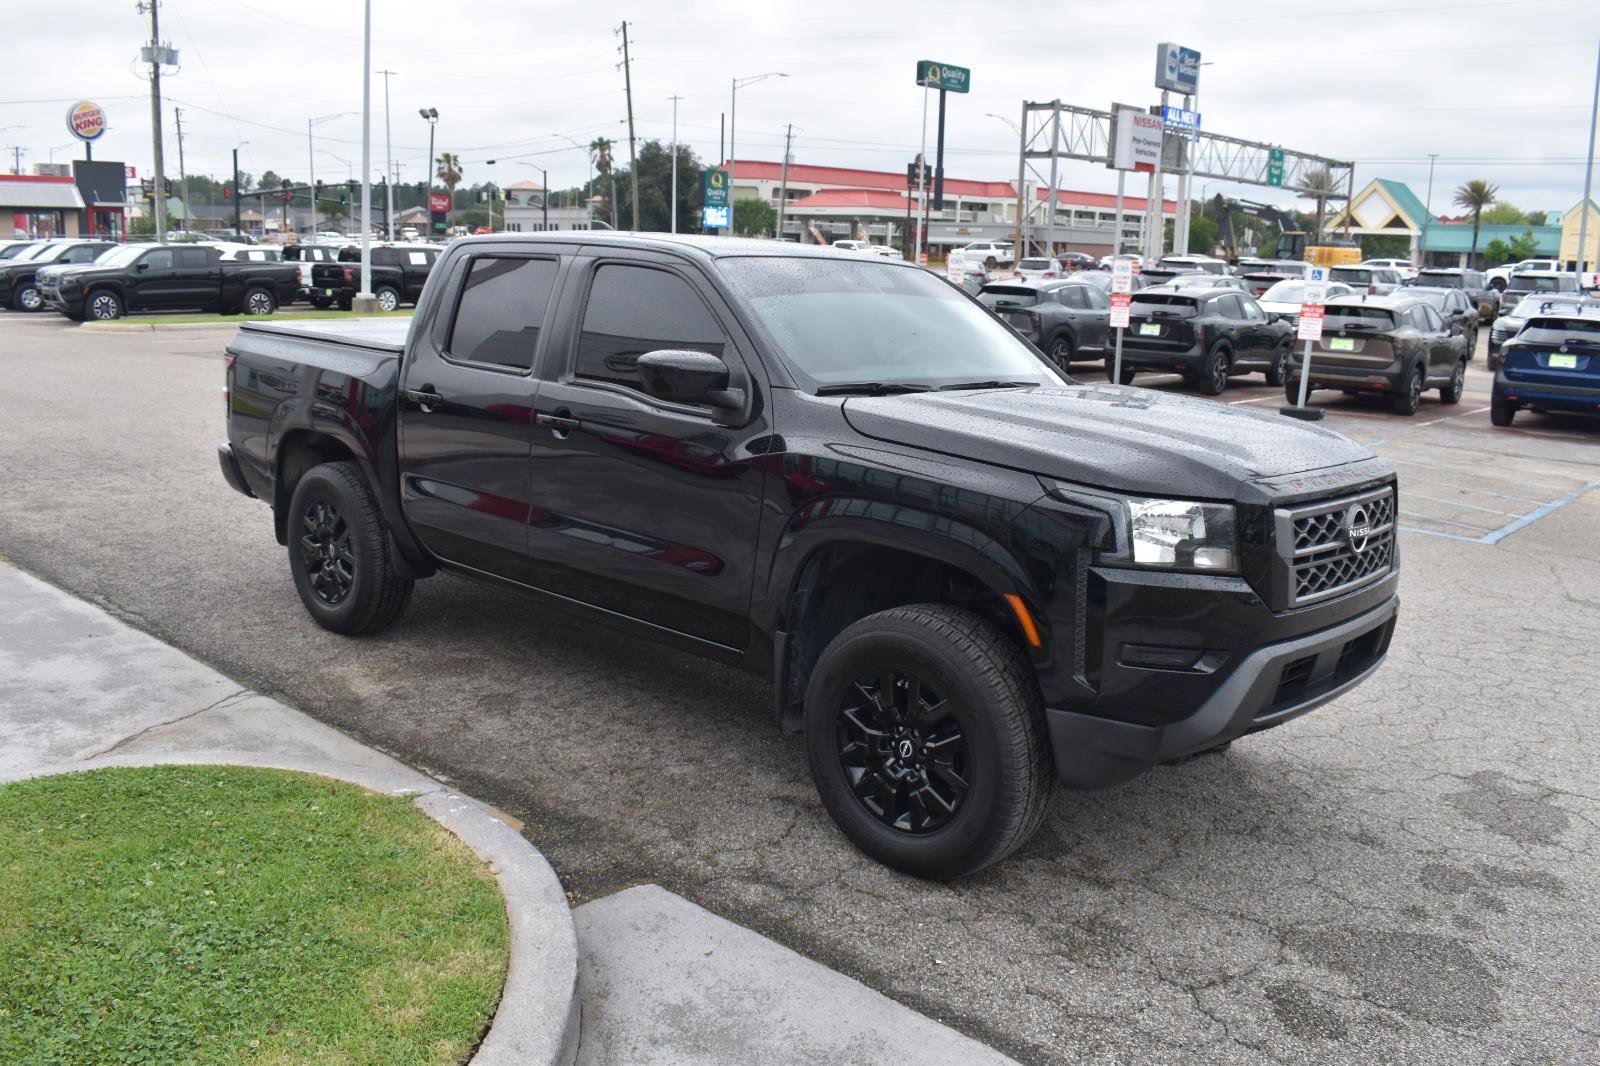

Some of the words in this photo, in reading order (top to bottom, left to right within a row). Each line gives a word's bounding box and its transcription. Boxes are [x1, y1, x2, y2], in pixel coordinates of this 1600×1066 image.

[942, 67, 965, 82] Quality
[73, 110, 101, 121] BURGER
[1167, 108, 1181, 121] ALL
[75, 117, 103, 130] KING
[1133, 116, 1162, 129] NISSAN
[1132, 136, 1160, 147] Pre-Owned
[1135, 148, 1157, 157] Vehicles
[707, 188, 726, 197] Quality
[1349, 527, 1370, 537] NISS
